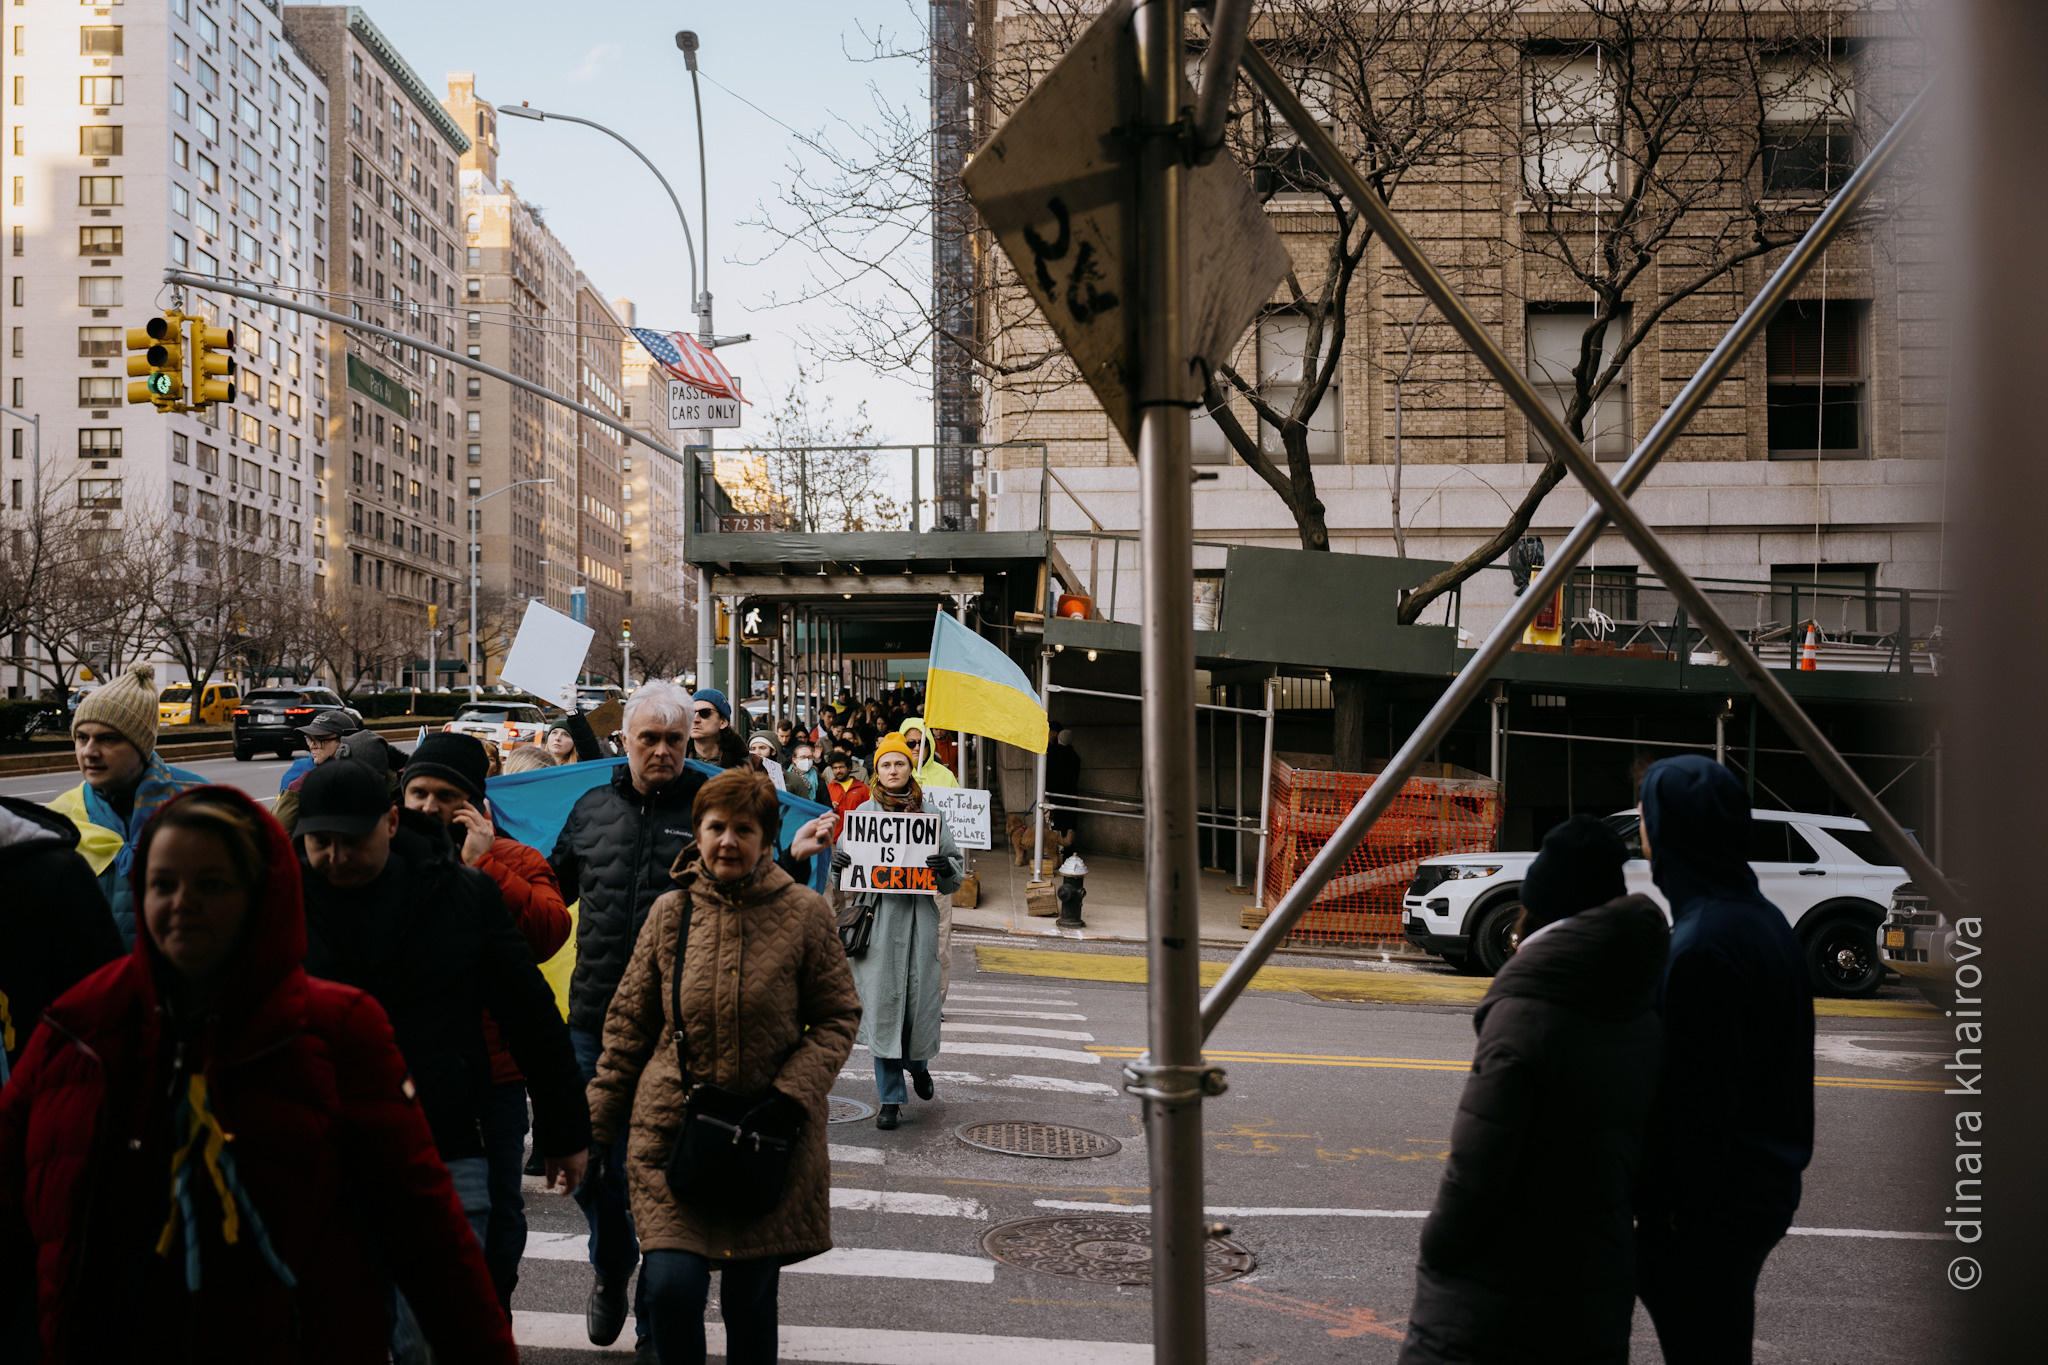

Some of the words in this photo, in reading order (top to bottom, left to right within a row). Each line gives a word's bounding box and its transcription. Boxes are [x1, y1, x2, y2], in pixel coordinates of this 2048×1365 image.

[370, 373, 384, 399] Park
[672, 385, 721, 400] PASSE
[672, 405, 700, 420] CARS
[707, 405, 736, 419] ONLY
[733, 518, 749, 531] 79
[753, 518, 766, 531] St
[938, 795, 954, 809] act
[954, 793, 986, 816] Today
[942, 809, 976, 825] Ukraine
[846, 814, 938, 845] INACTION
[963, 826, 986, 840] LATE
[880, 846, 895, 863] IS
[850, 864, 867, 888] A
[871, 865, 938, 891] CRIME
